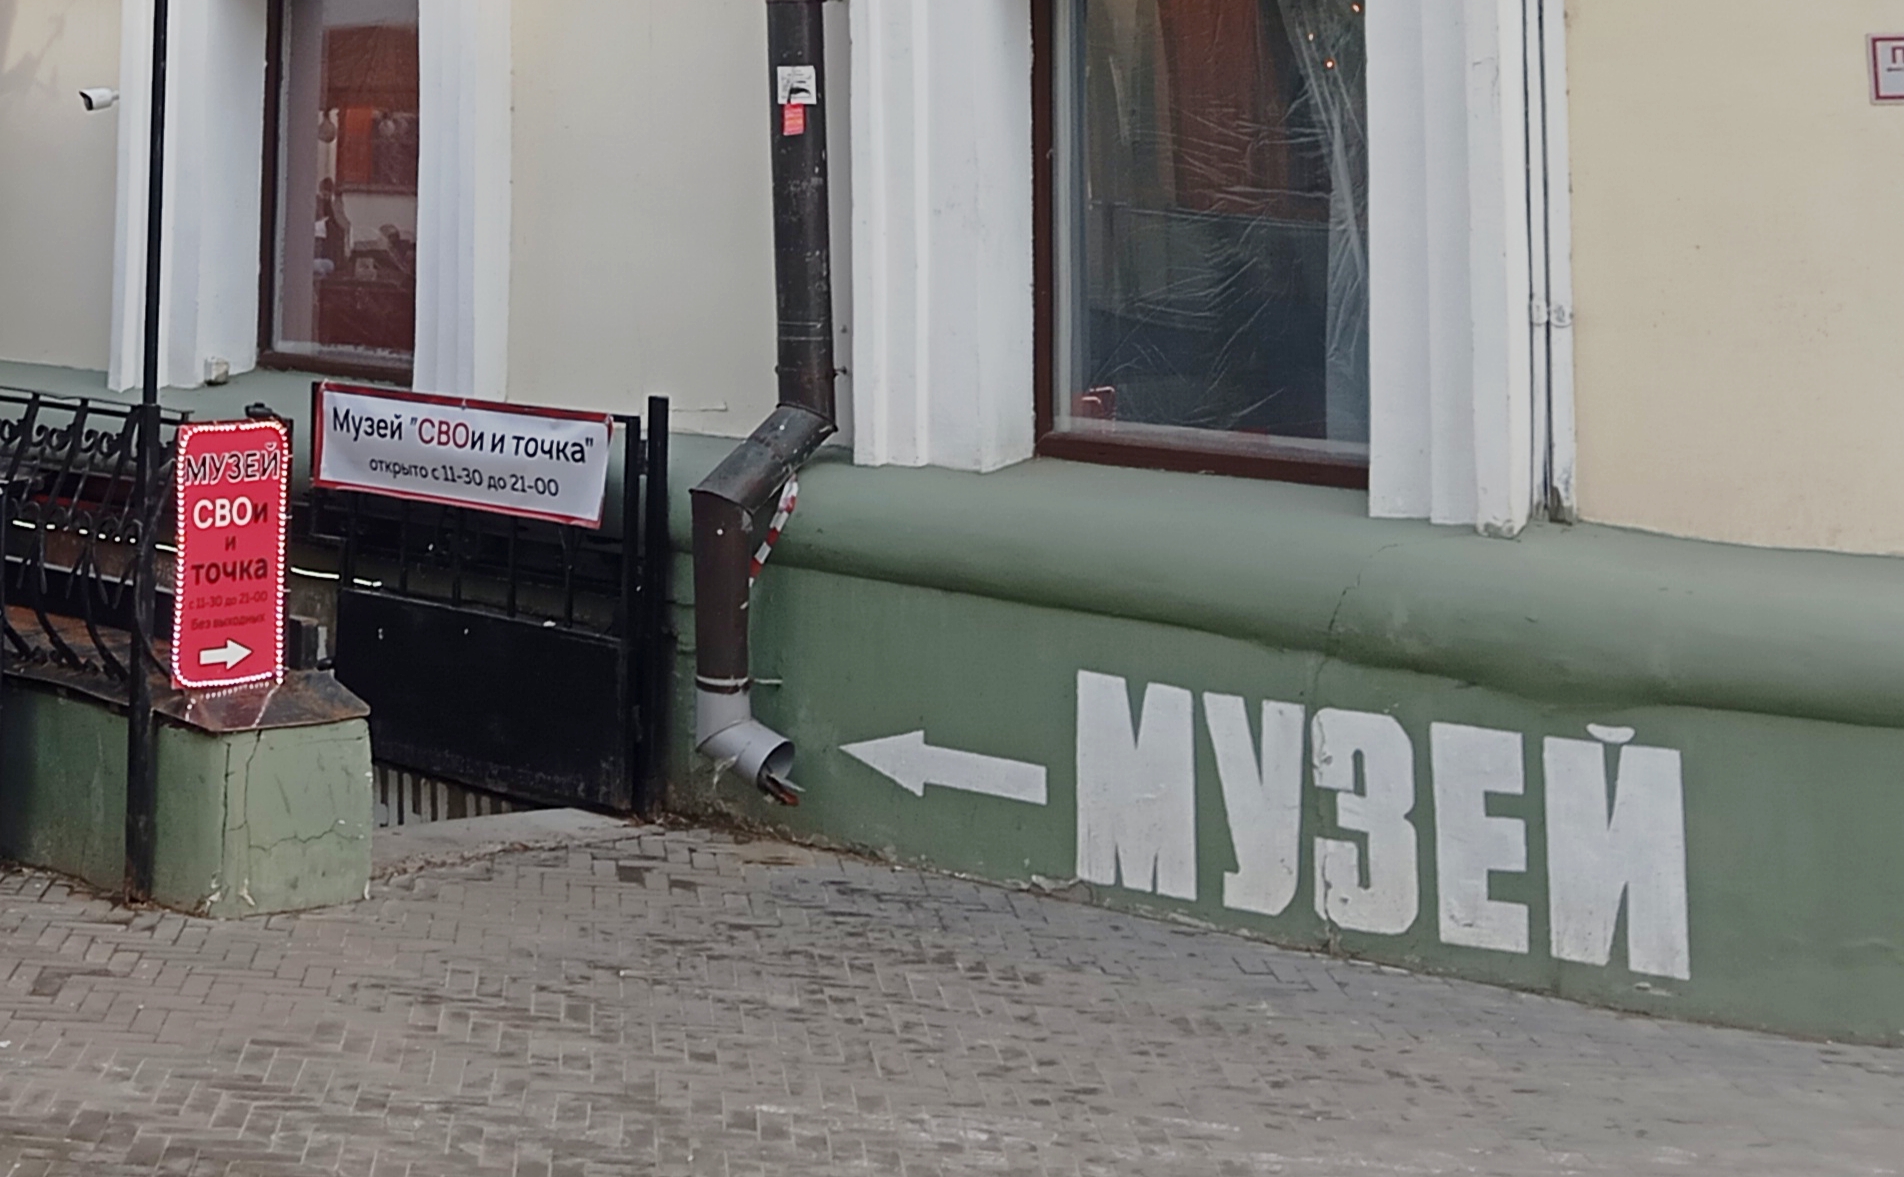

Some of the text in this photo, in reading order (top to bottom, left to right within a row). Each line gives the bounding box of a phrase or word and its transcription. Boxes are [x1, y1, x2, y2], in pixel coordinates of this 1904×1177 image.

[332, 406, 403, 442] Музей
[511, 434, 594, 464] точка"
[184, 441, 281, 487] МУЗЕЙ
[369, 457, 560, 498] открыто с 11-30 до 21-00
[193, 496, 268, 529] СВОи
[225, 535, 236, 552] и
[191, 557, 269, 586] точка
[196, 594, 224, 610] 11-30
[238, 590, 268, 606] 21-00
[1076, 670, 1691, 980] МУЗЕЙ
